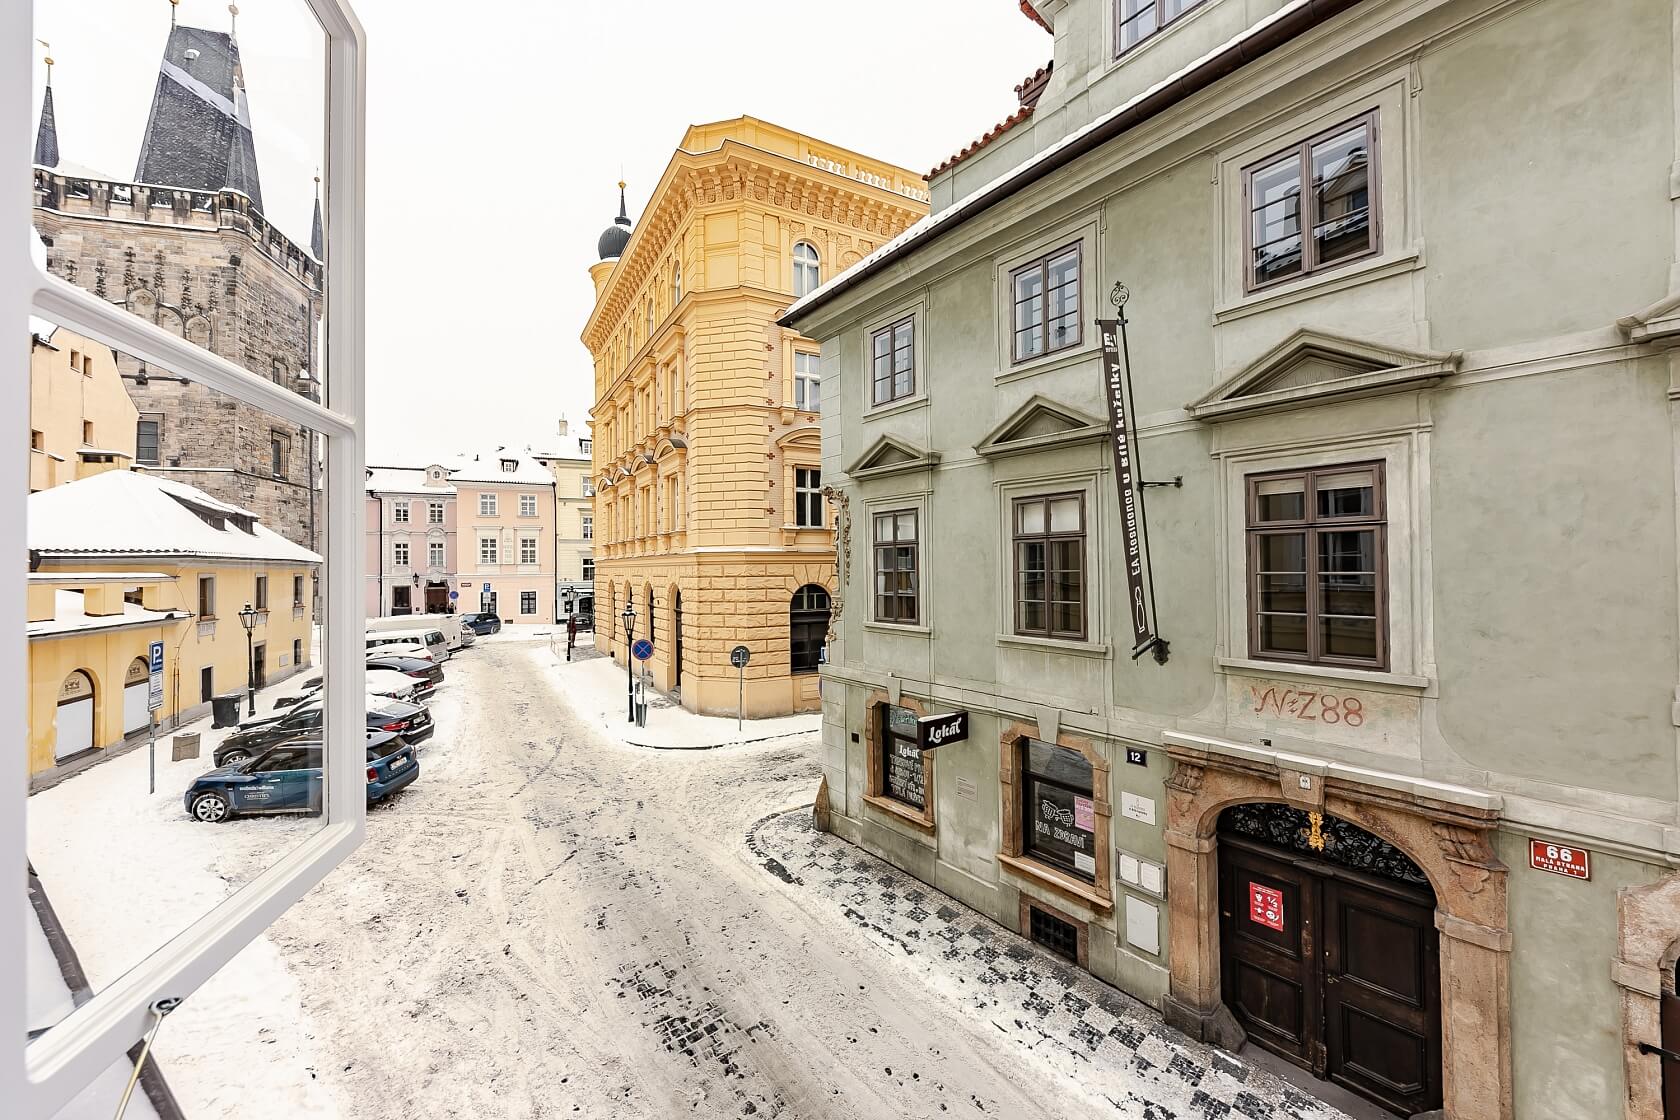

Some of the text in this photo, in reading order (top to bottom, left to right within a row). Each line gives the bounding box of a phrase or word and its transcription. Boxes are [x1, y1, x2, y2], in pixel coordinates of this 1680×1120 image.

[1111, 363, 1126, 429] kuželky
[1124, 489, 1139, 556] Residence
[1132, 558, 1140, 576] EA
[1130, 752, 1141, 762] 12
[1035, 820, 1051, 836] NA
[1546, 845, 1572, 862] 66
